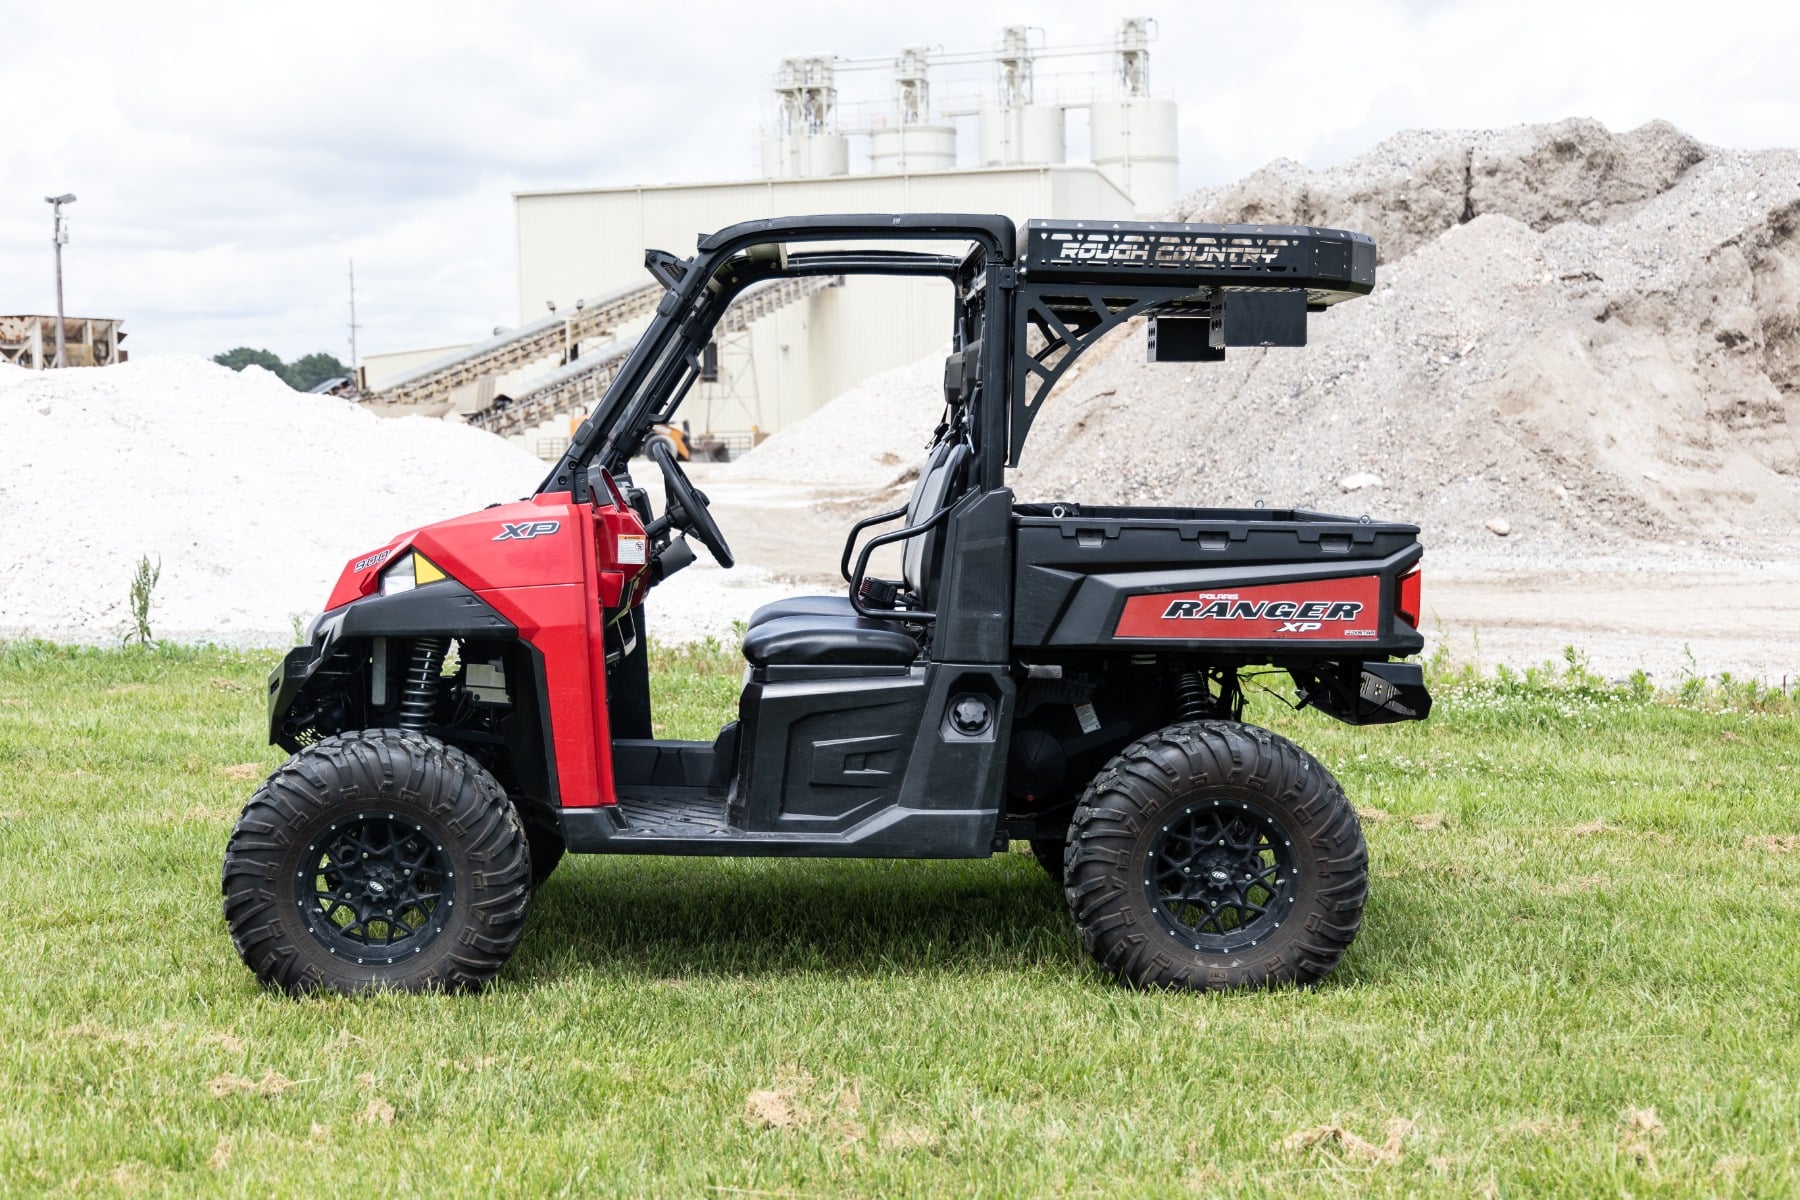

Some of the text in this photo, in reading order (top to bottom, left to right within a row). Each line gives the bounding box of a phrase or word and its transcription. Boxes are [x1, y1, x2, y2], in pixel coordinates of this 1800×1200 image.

[1060, 243, 1279, 264] ROUGH COUNTRY
[492, 521, 560, 541] XP
[1161, 600, 1364, 620] RANGER
[1275, 622, 1322, 632] XP
